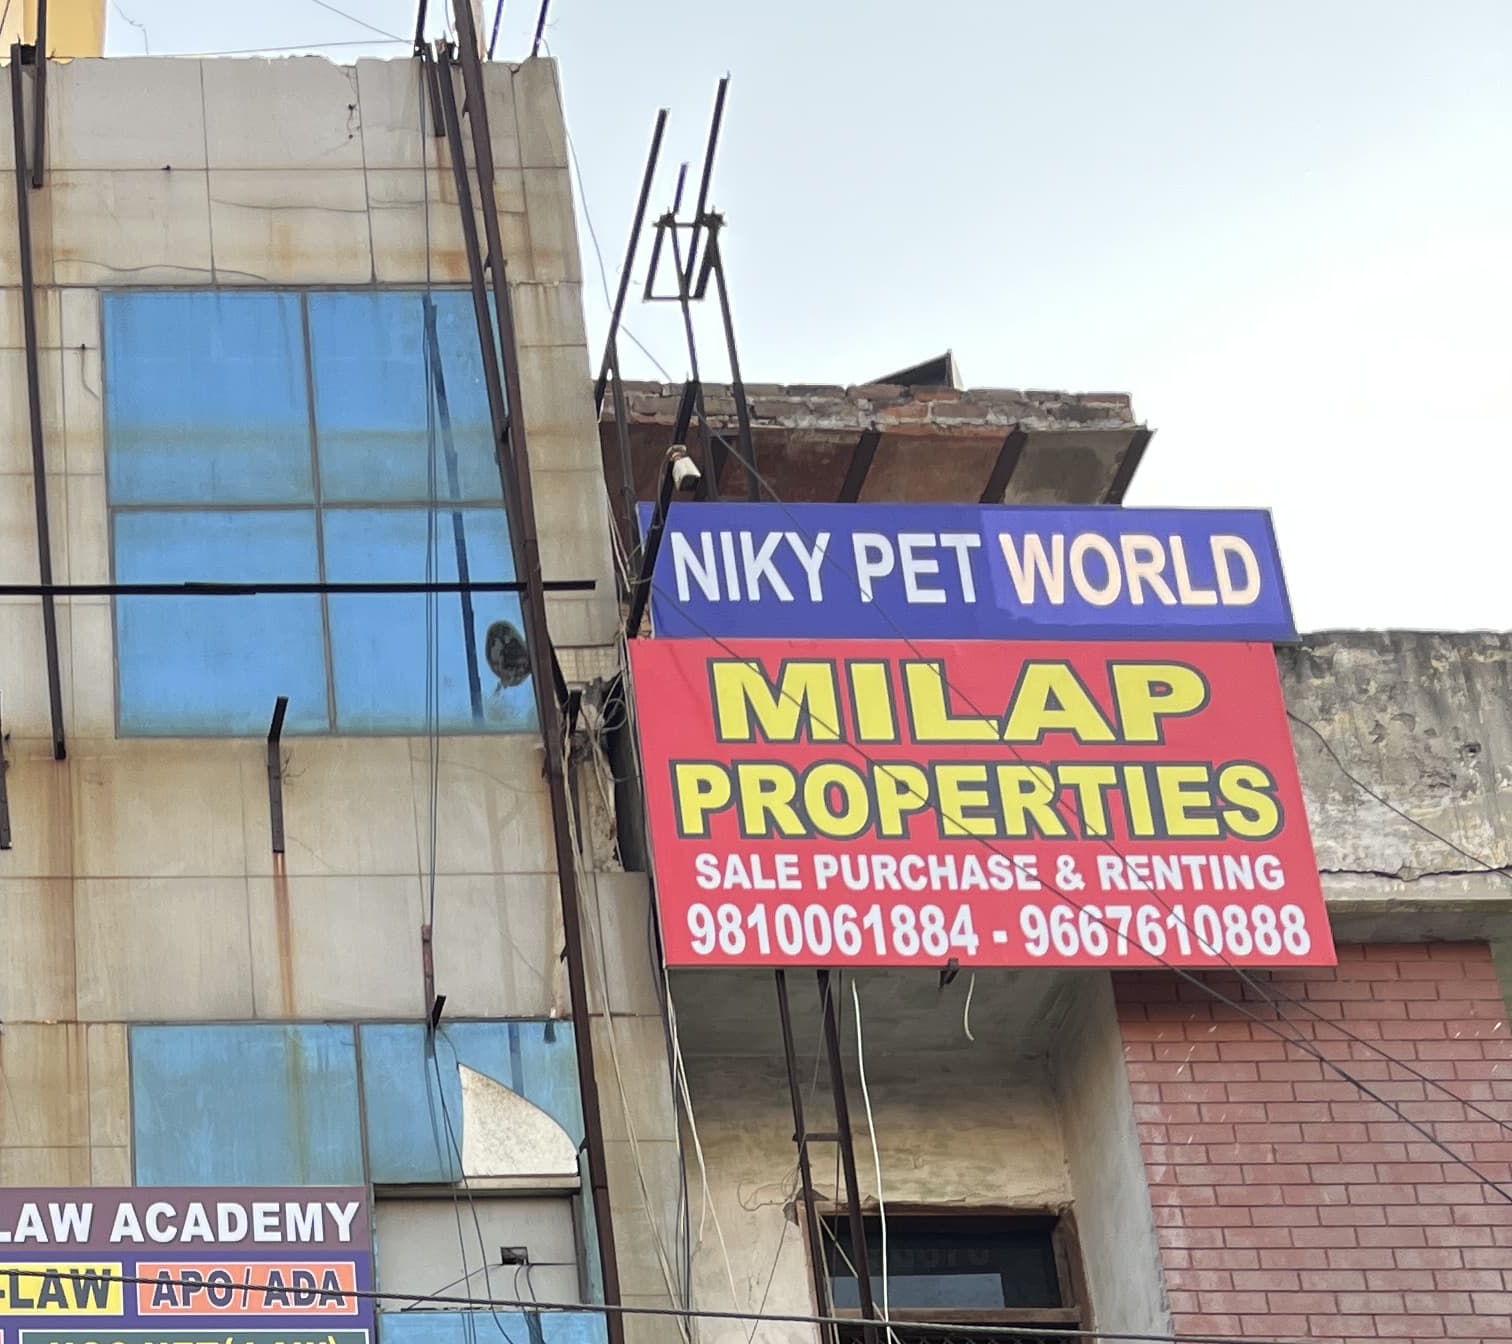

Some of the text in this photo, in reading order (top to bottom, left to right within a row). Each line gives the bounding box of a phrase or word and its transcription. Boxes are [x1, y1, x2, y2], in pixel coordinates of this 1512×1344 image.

[671, 531, 1262, 606] NIKY PET WORLD
[707, 658, 1210, 744] MILAP
[669, 761, 1283, 841] PROPERTIES
[695, 853, 1285, 892] SALE PURCHASE & RENTING
[689, 904, 1311, 958] 9810061884 9667610888
[111, 1200, 360, 1243] ACADEMY
